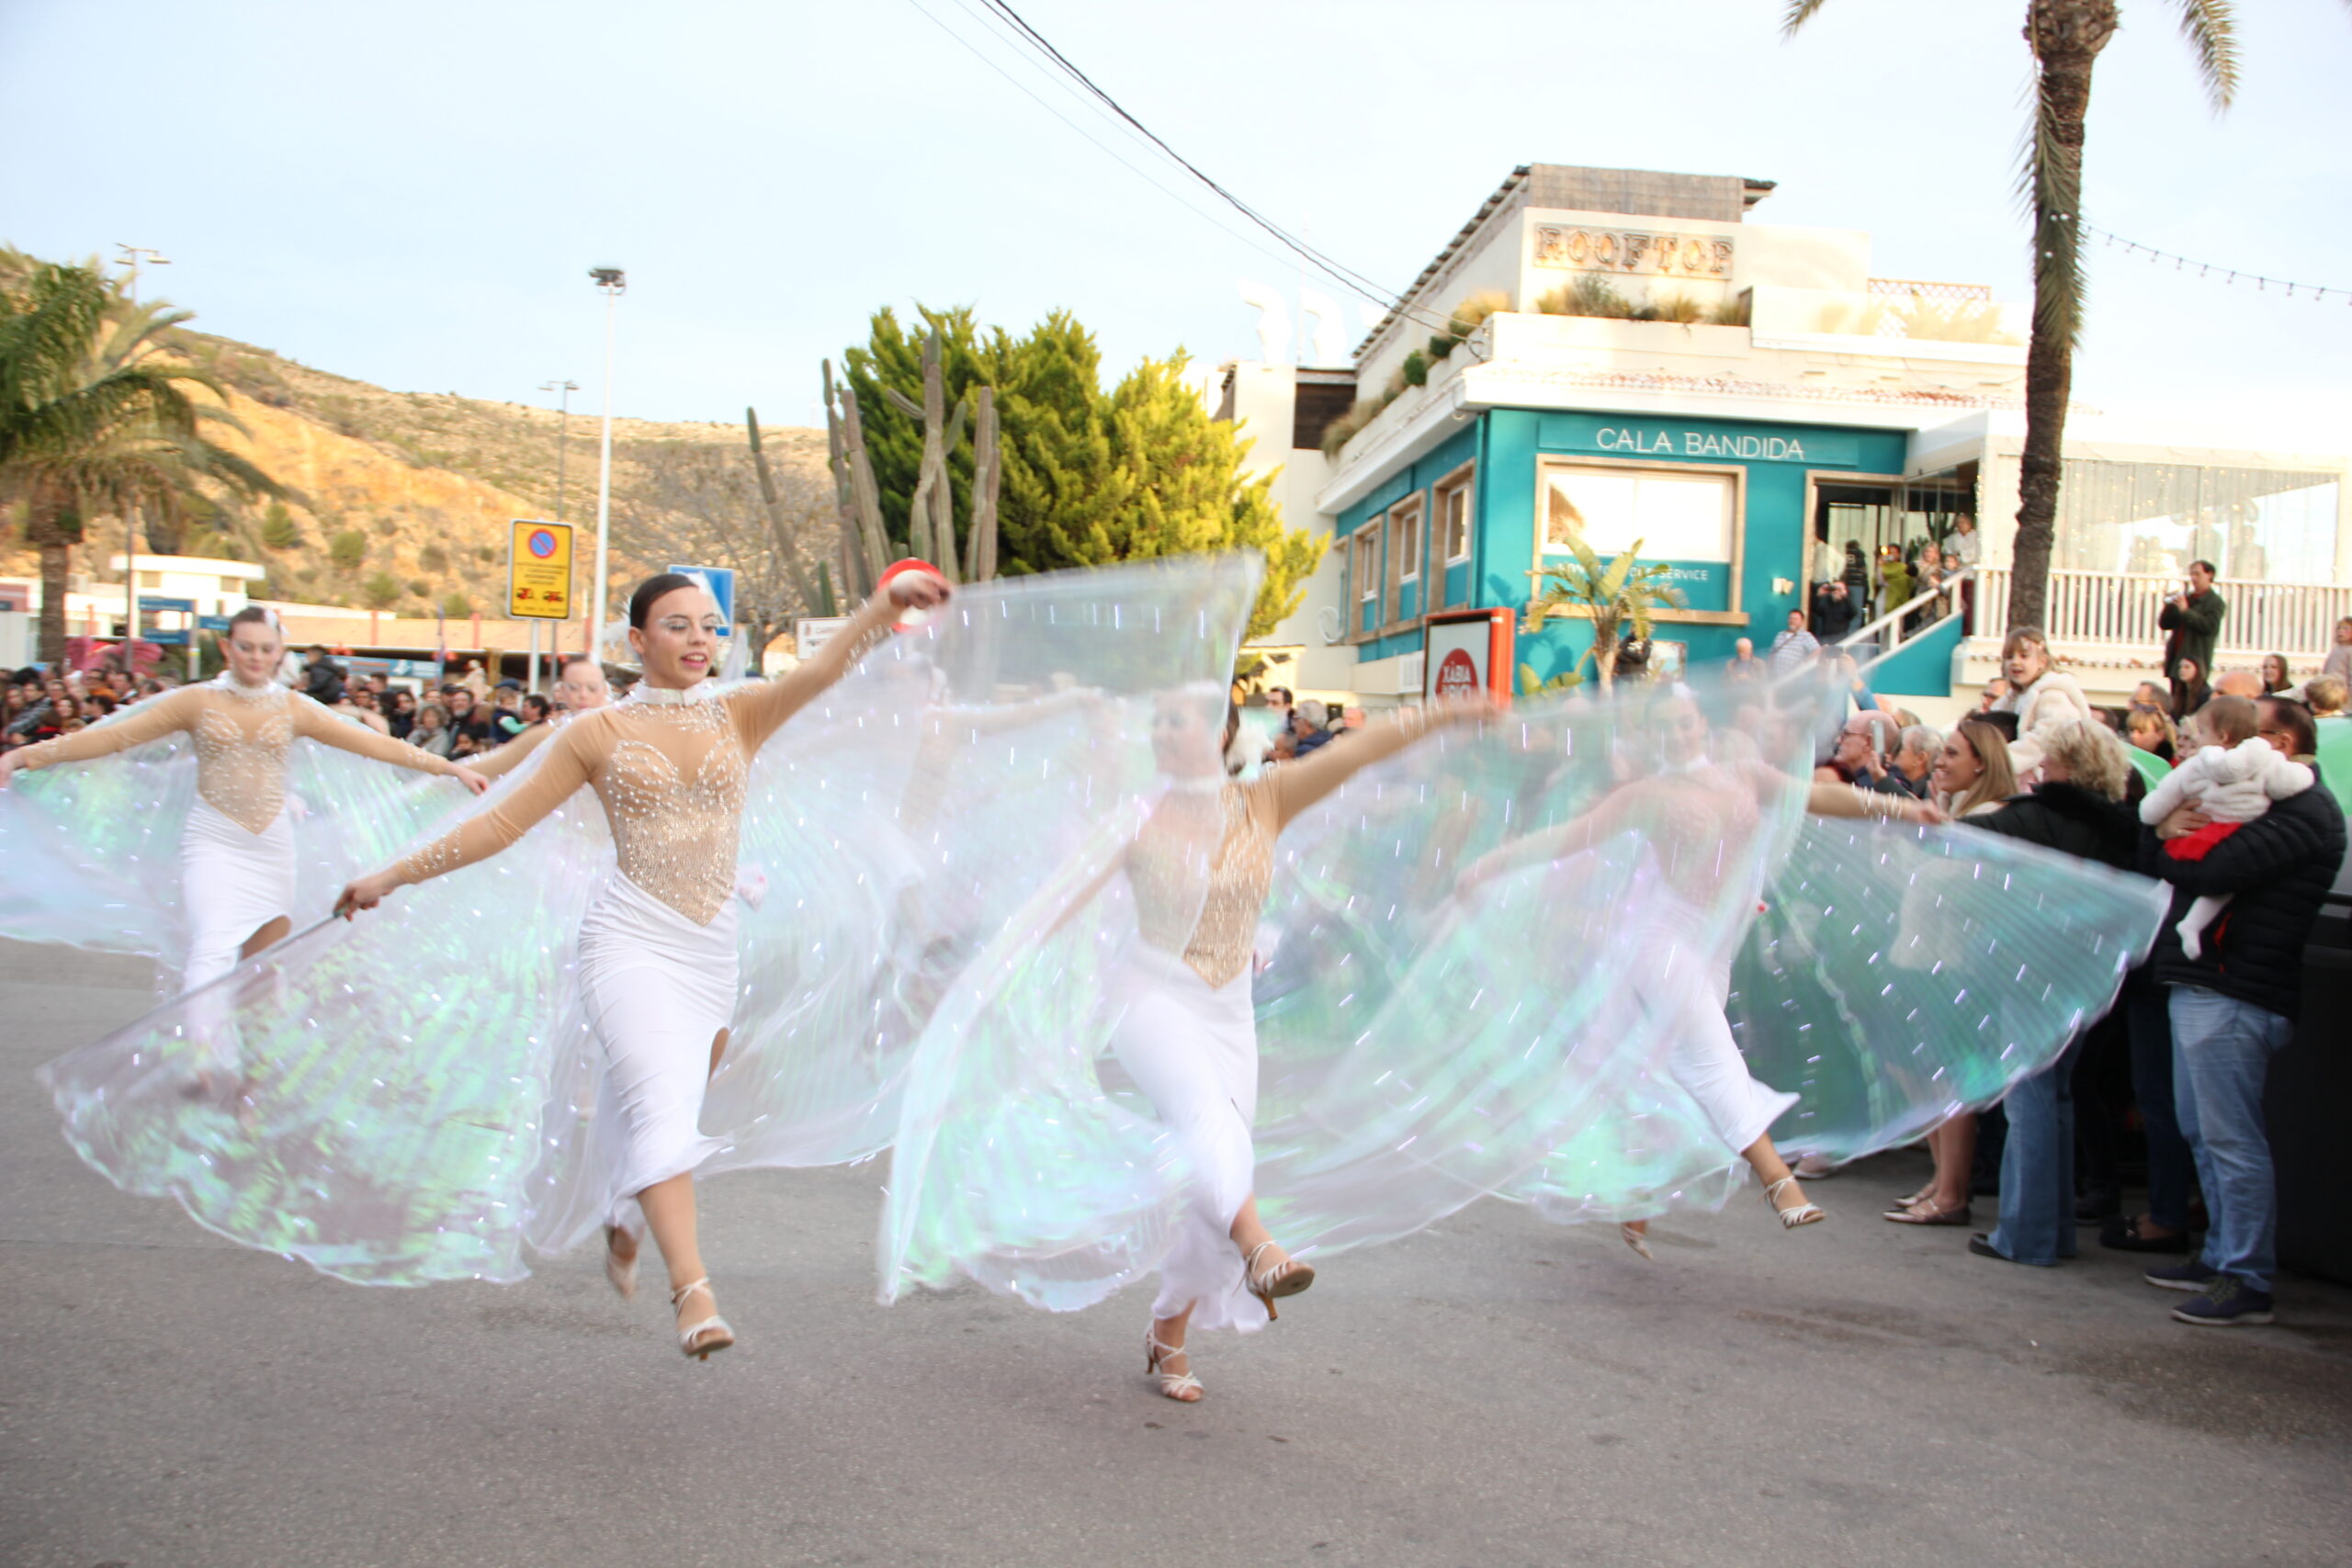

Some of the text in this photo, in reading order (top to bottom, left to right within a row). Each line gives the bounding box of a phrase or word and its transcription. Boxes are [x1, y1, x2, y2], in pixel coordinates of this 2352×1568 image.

[1537, 227, 1734, 273] ROOFTOP
[1596, 427, 1805, 460] CALA BANDIDA
[1658, 568, 1709, 581] SERVICE
